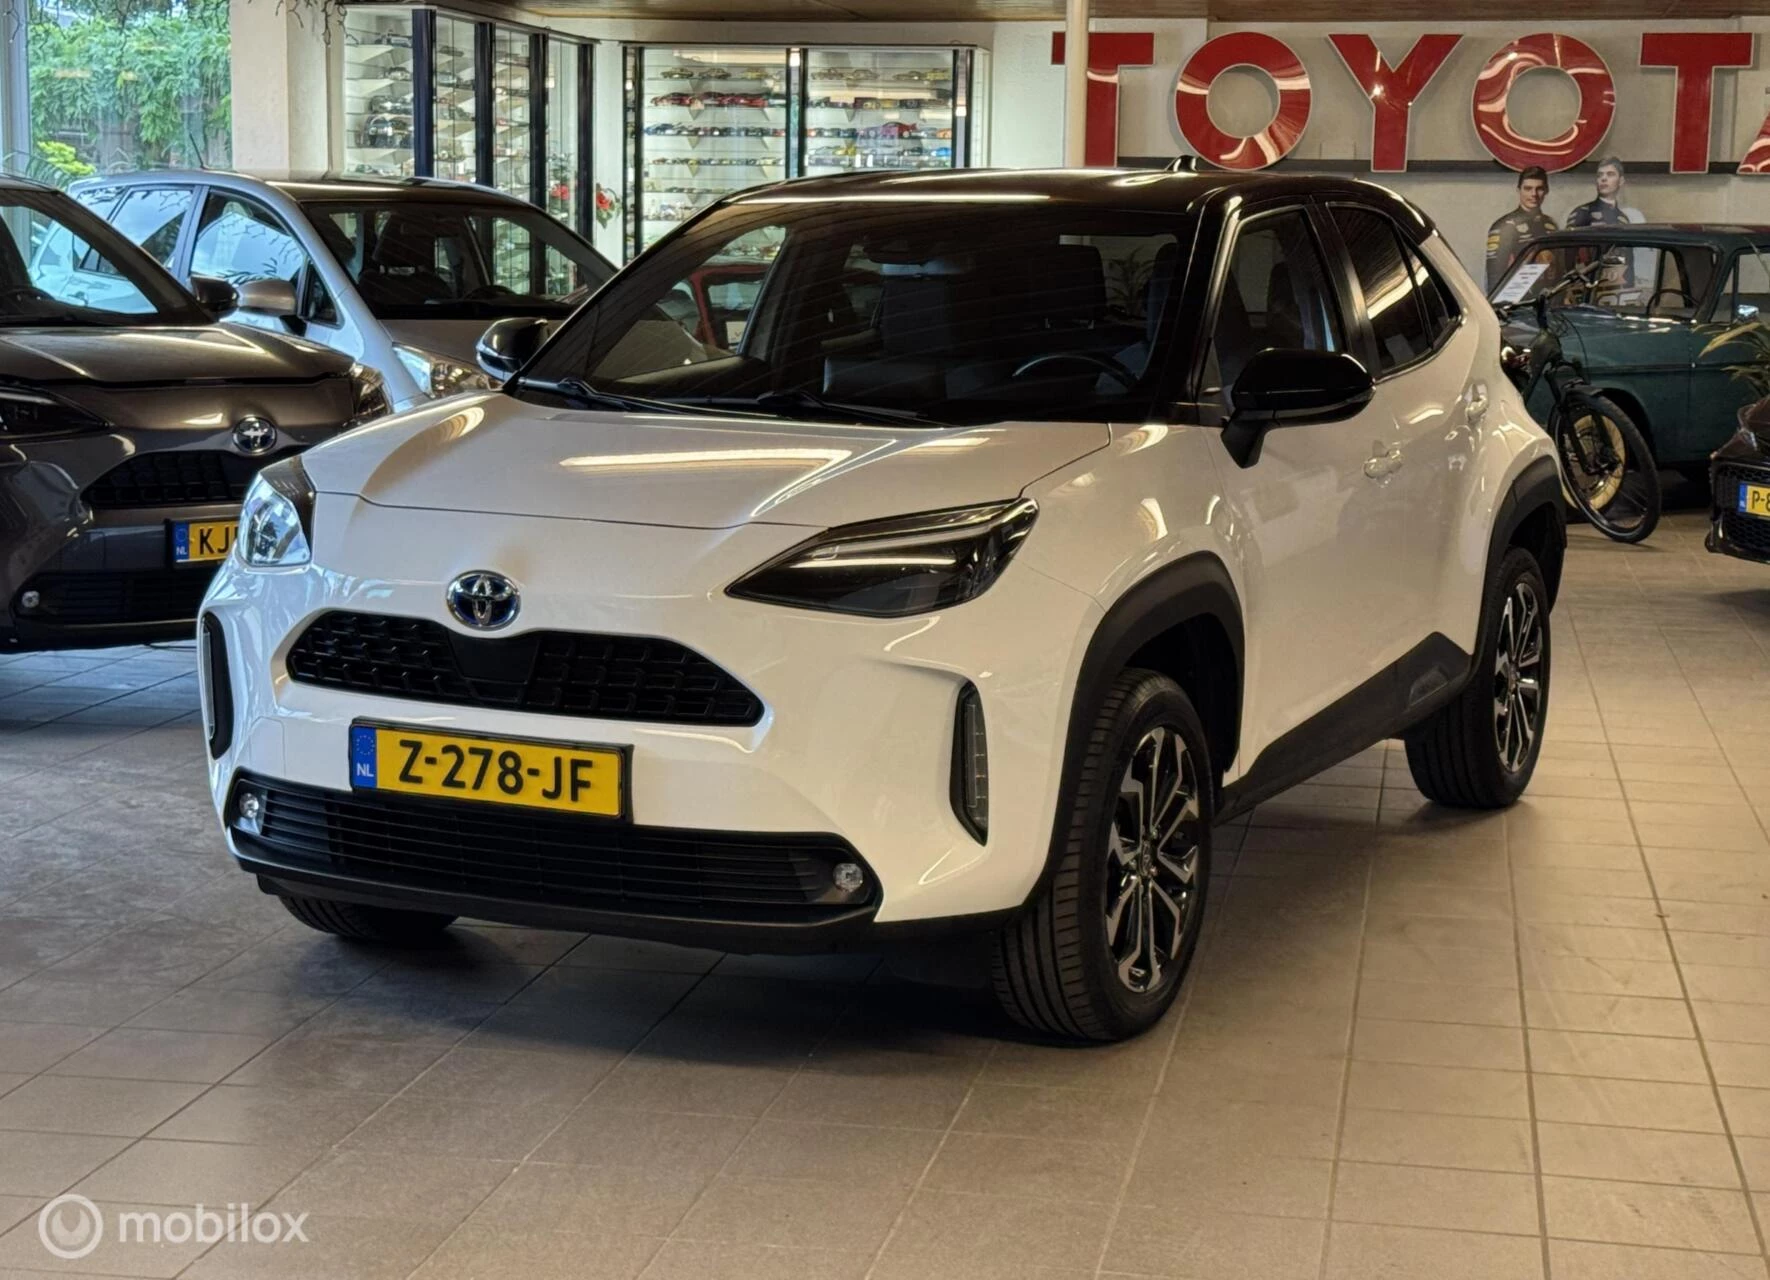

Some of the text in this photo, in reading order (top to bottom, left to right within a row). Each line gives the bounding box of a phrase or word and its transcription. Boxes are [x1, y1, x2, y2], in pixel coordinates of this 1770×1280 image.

[1051, 32, 1770, 175] TOYOT
[199, 526, 239, 555] KJ
[356, 739, 593, 802] NL Z-278-JF
